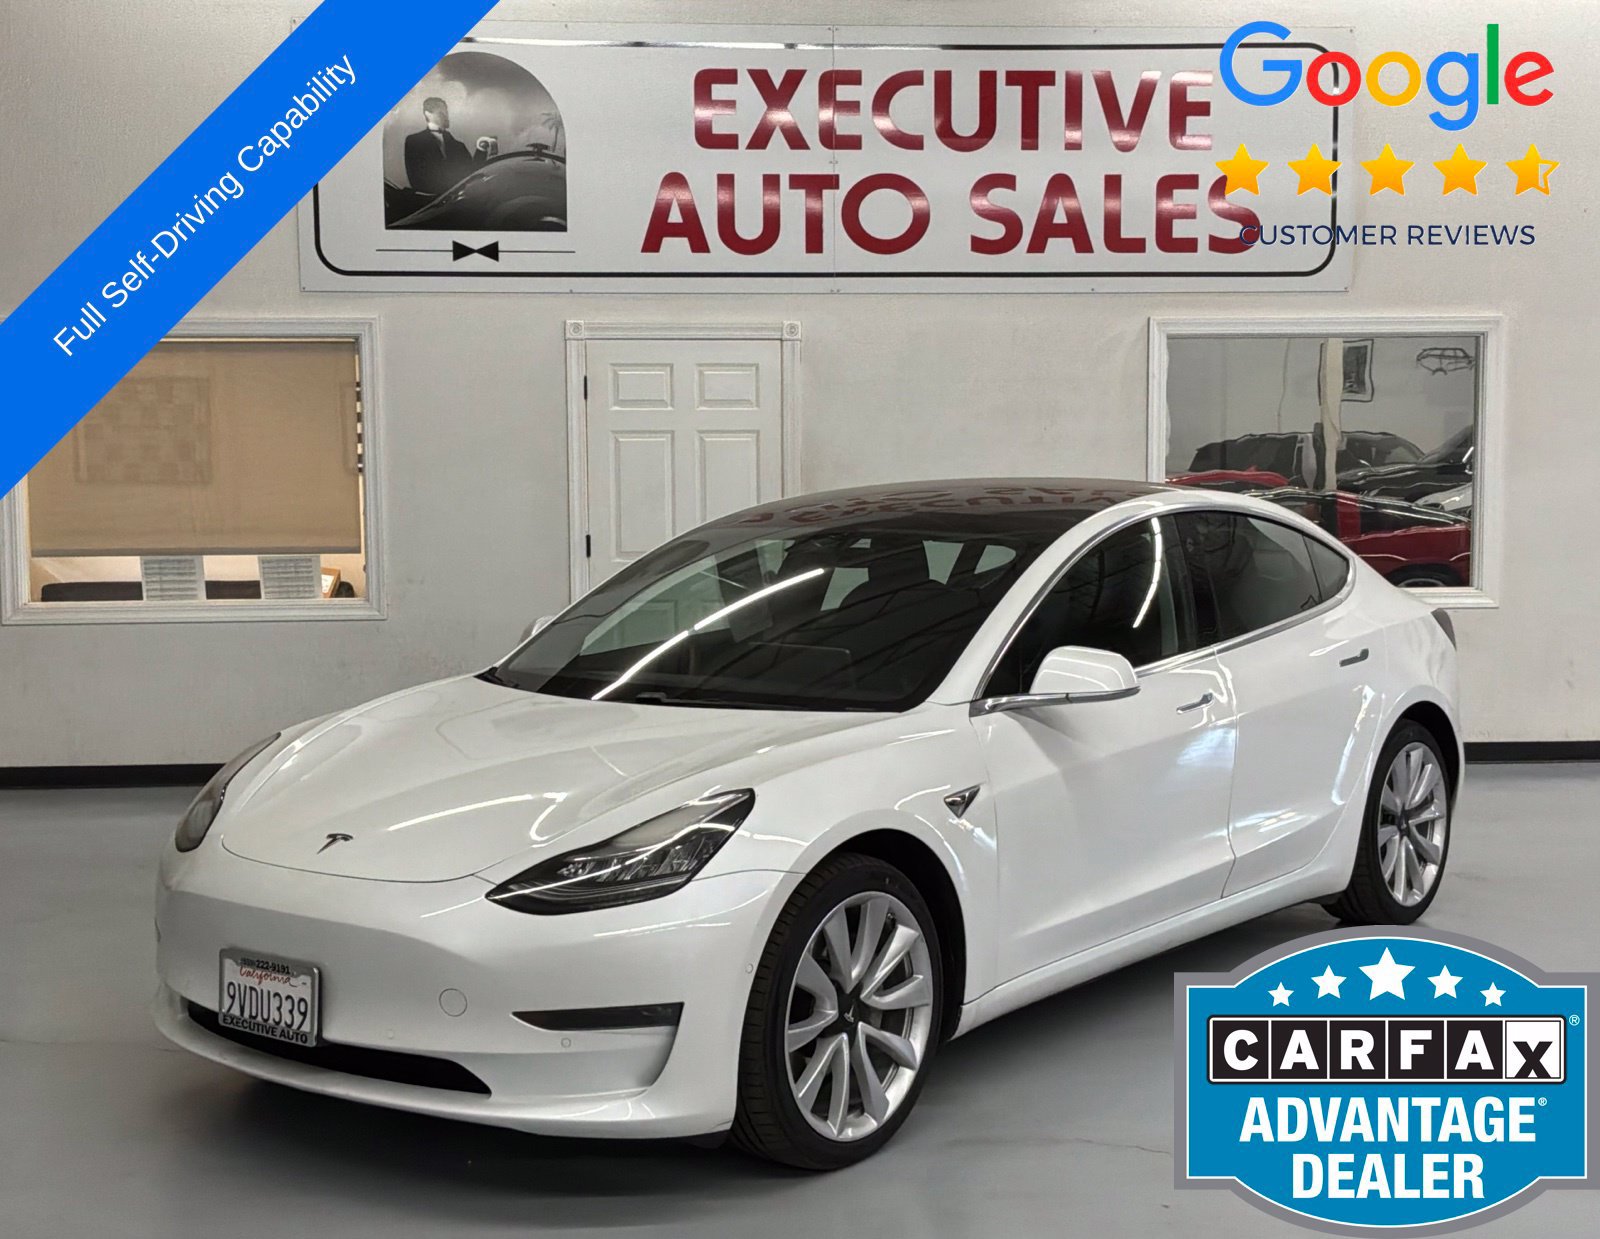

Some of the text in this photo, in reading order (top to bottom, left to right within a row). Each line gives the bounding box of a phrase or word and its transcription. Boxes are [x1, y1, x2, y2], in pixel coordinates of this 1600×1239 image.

[693, 69, 1213, 151] EXECUTIVE
[641, 173, 1261, 255] AUTO SALES
[222, 1015, 308, 1044] EXECUTIVE AUTO
[226, 981, 309, 1031] 9VDU339
